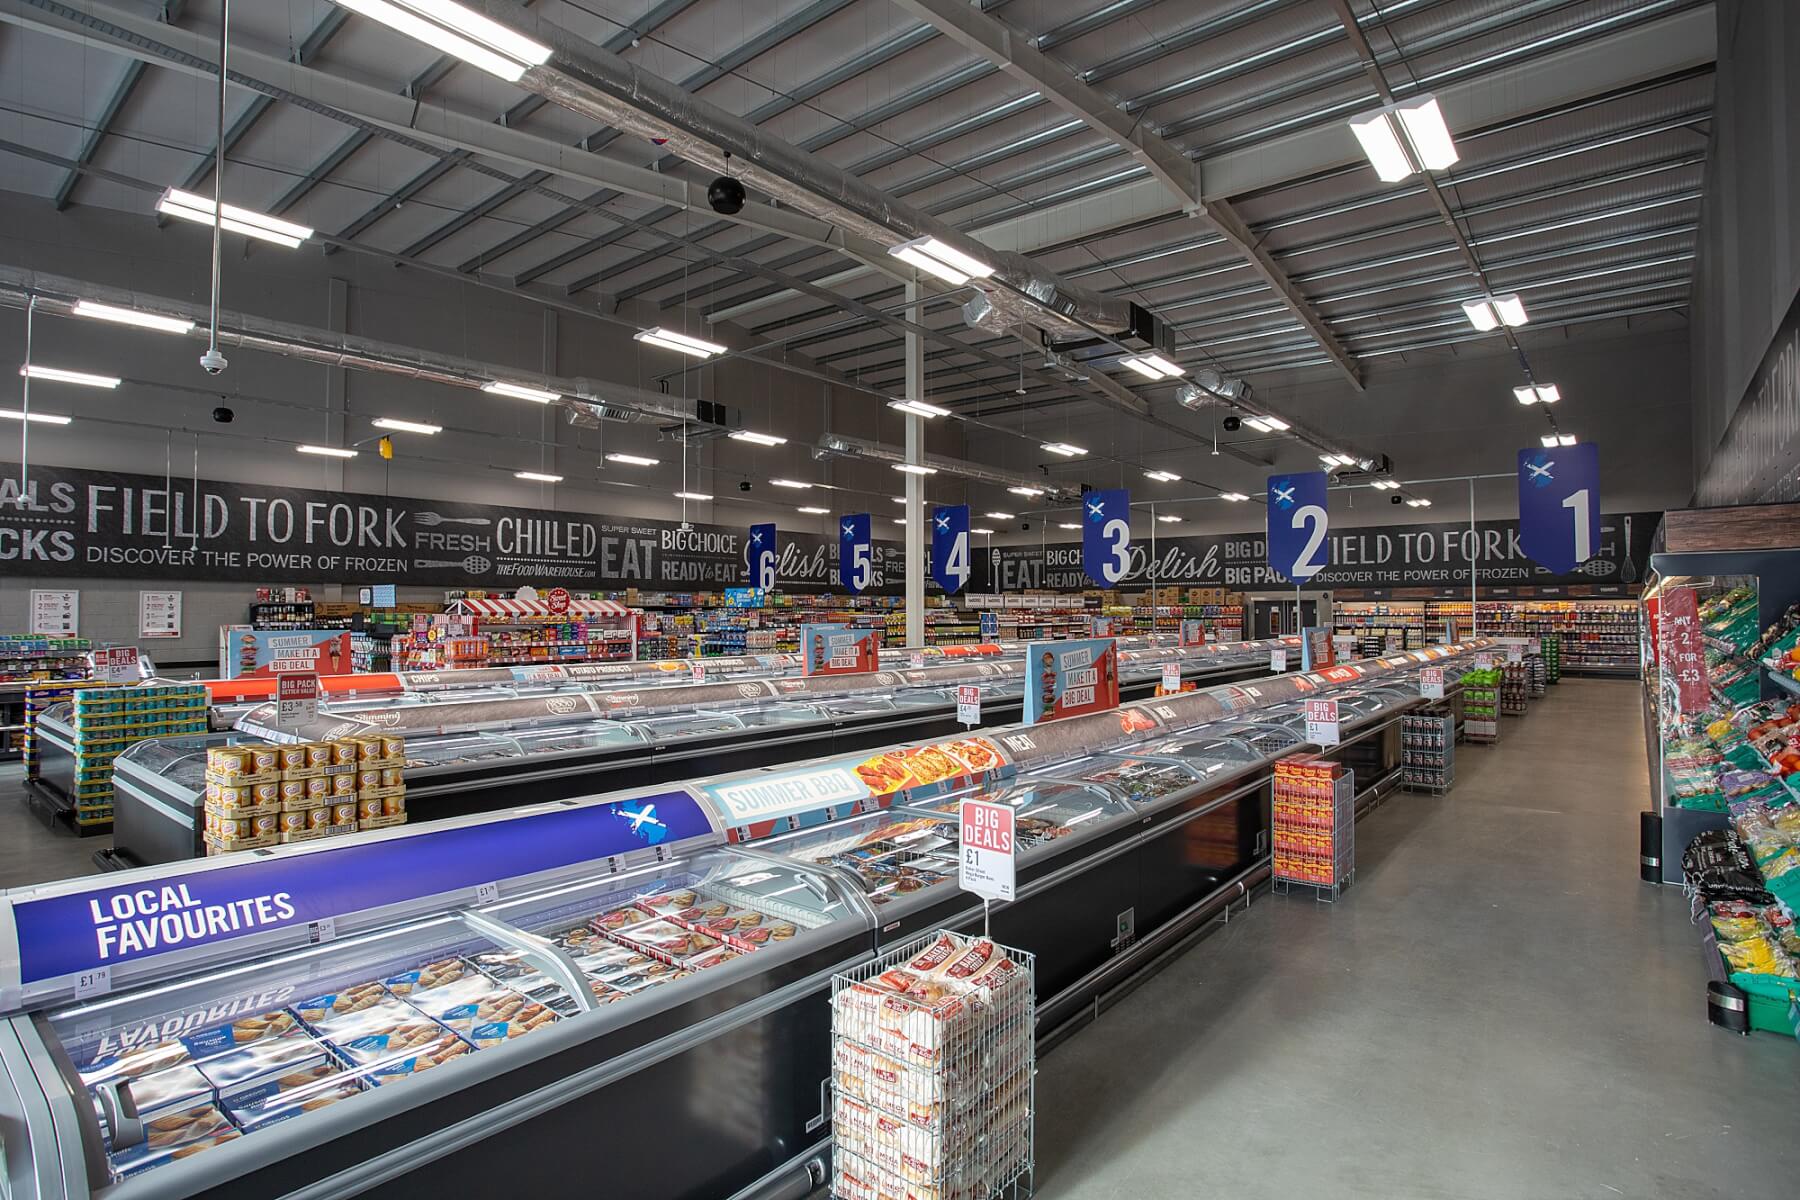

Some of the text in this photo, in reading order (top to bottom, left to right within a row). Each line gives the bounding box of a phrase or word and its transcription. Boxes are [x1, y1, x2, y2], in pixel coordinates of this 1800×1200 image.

[87, 484, 407, 549] FIELD TO FORK
[601, 524, 657, 536] SUPER SWEET
[1562, 489, 1590, 563] 1
[415, 531, 491, 552] FRESH
[496, 517, 597, 558] CHILLED
[661, 529, 738, 554] BIG CHOICE
[1291, 504, 1329, 577] 2
[1102, 519, 1130, 583] 3
[1224, 541, 1251, 559] BIG
[1327, 528, 1527, 565] IELD TO FORK
[86, 546, 408, 573] DISCOVER THE POWER OF FROZEN
[601, 536, 657, 580] EAT
[945, 531, 970, 587] 4
[1046, 549, 1068, 566] BIG
[661, 561, 706, 582] READY
[715, 563, 738, 583] EAT
[759, 550, 775, 593] 6
[853, 543, 871, 590] 5
[885, 560, 905, 573] FRE
[1002, 559, 1043, 589] EAT
[1316, 567, 1529, 583] DISCOVER THE POWER OF FROZEN
[1046, 572, 1084, 588] READY
[1224, 567, 1251, 585] BIG
[1674, 616, 1691, 625] ANY
[272, 636, 310, 648] SUMMER
[1681, 632, 1690, 645] 2
[110, 656, 137, 665] DEALS
[115, 649, 130, 658] BIG
[277, 649, 318, 659] MAKE IT A
[1063, 652, 1089, 669] SUMMER
[1679, 652, 1697, 662] FOR
[272, 660, 310, 670] BIG DEAL
[410, 674, 440, 684] CHIPS
[1067, 672, 1085, 686] MAKE
[1085, 670, 1091, 684] IT
[1681, 668, 1700, 682] £3
[281, 679, 316, 689] BIG PACK
[963, 687, 974, 696] BIG
[959, 695, 978, 704] DEALS
[1065, 690, 1091, 705] BIG DEAL
[1313, 702, 1329, 712] BIG
[353, 711, 401, 727] Slimming
[1308, 711, 1336, 722] DEALS
[1002, 734, 1037, 752] MEAT
[727, 767, 851, 813] SUMMER BBQ
[974, 806, 999, 829] BIG
[965, 823, 1010, 851] DEALS
[966, 848, 979, 866] £1
[90, 883, 202, 925] LOCAL
[96, 892, 296, 960] FAVOURITES
